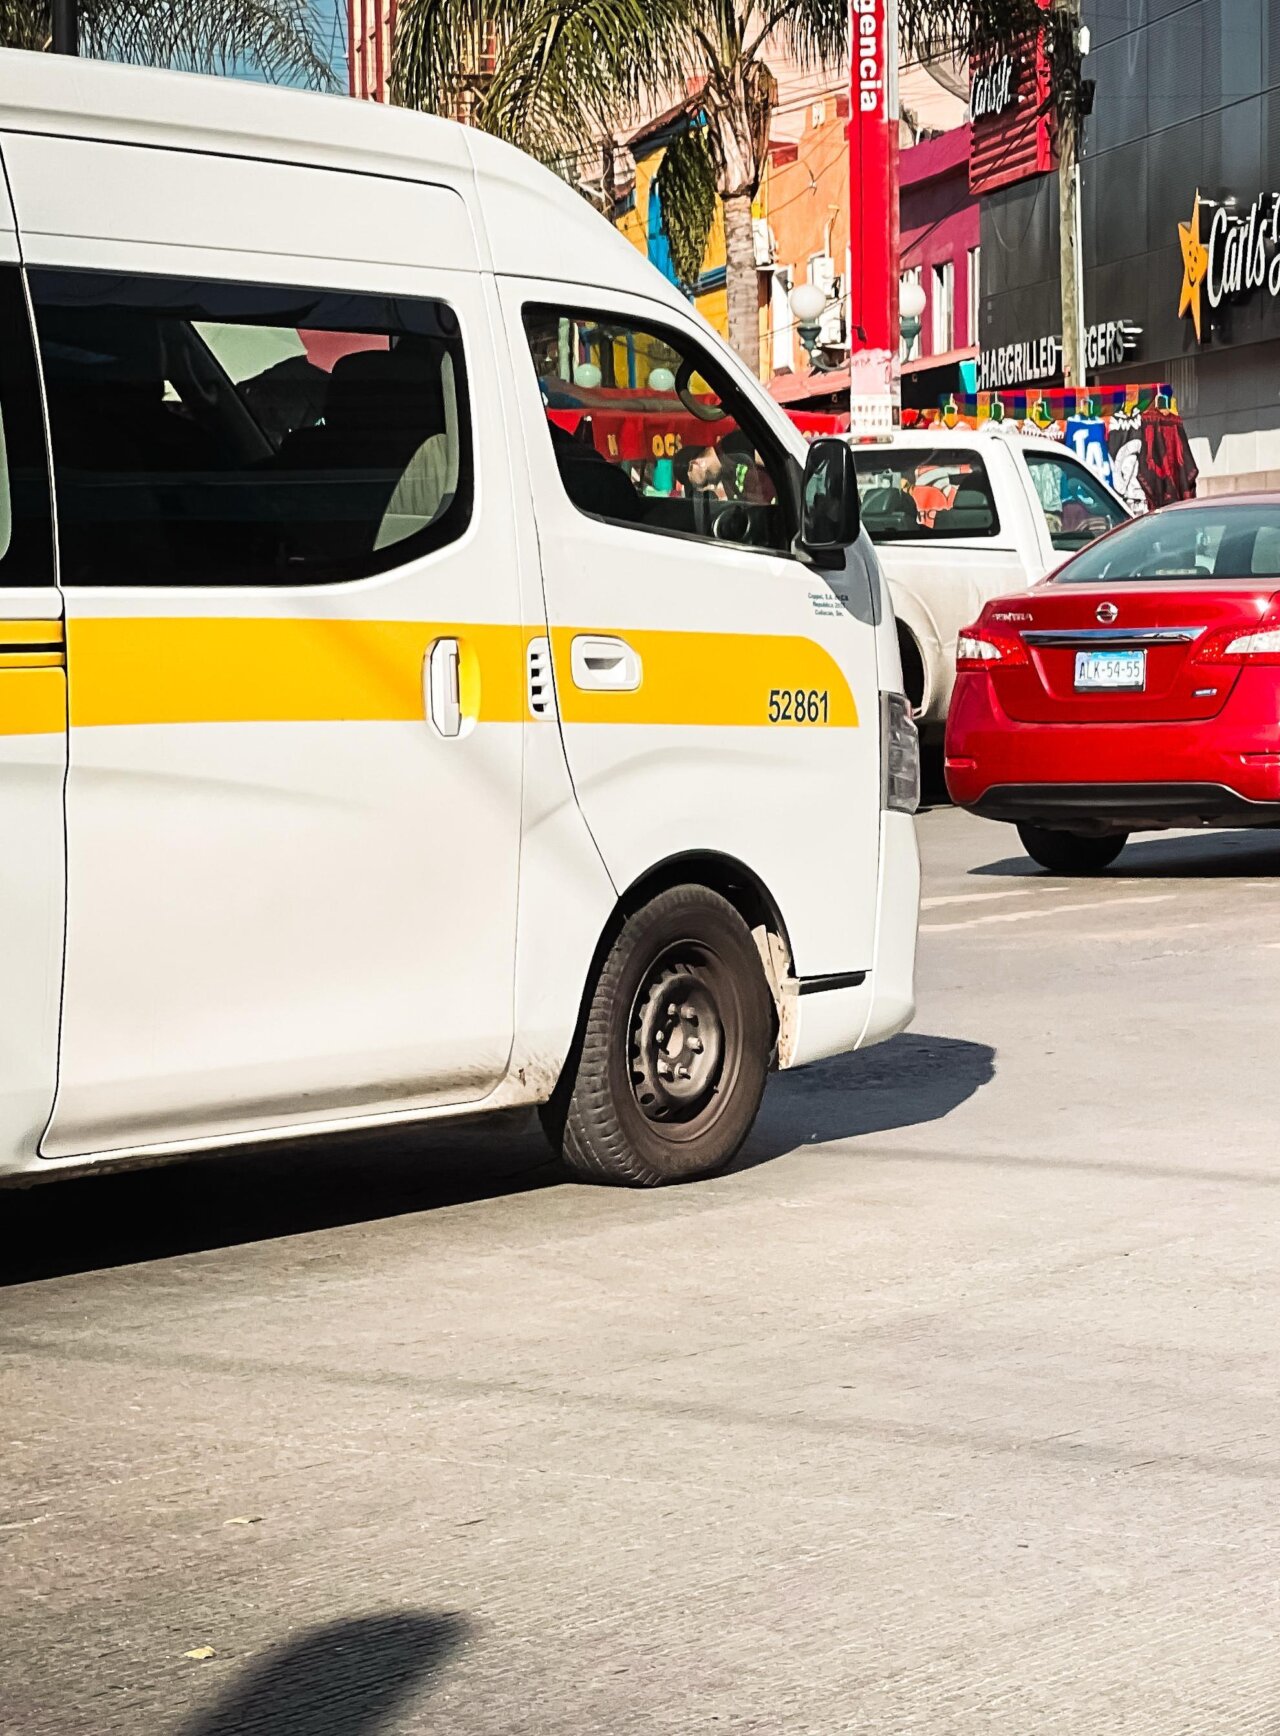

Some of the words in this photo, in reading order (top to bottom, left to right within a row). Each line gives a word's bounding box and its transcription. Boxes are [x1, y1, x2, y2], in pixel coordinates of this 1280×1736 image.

[1207, 191, 1268, 308] Carl's
[975, 335, 1056, 391] CHARGRILLED
[1079, 661, 1140, 679] ALK-54-55
[768, 689, 829, 723] 52861
